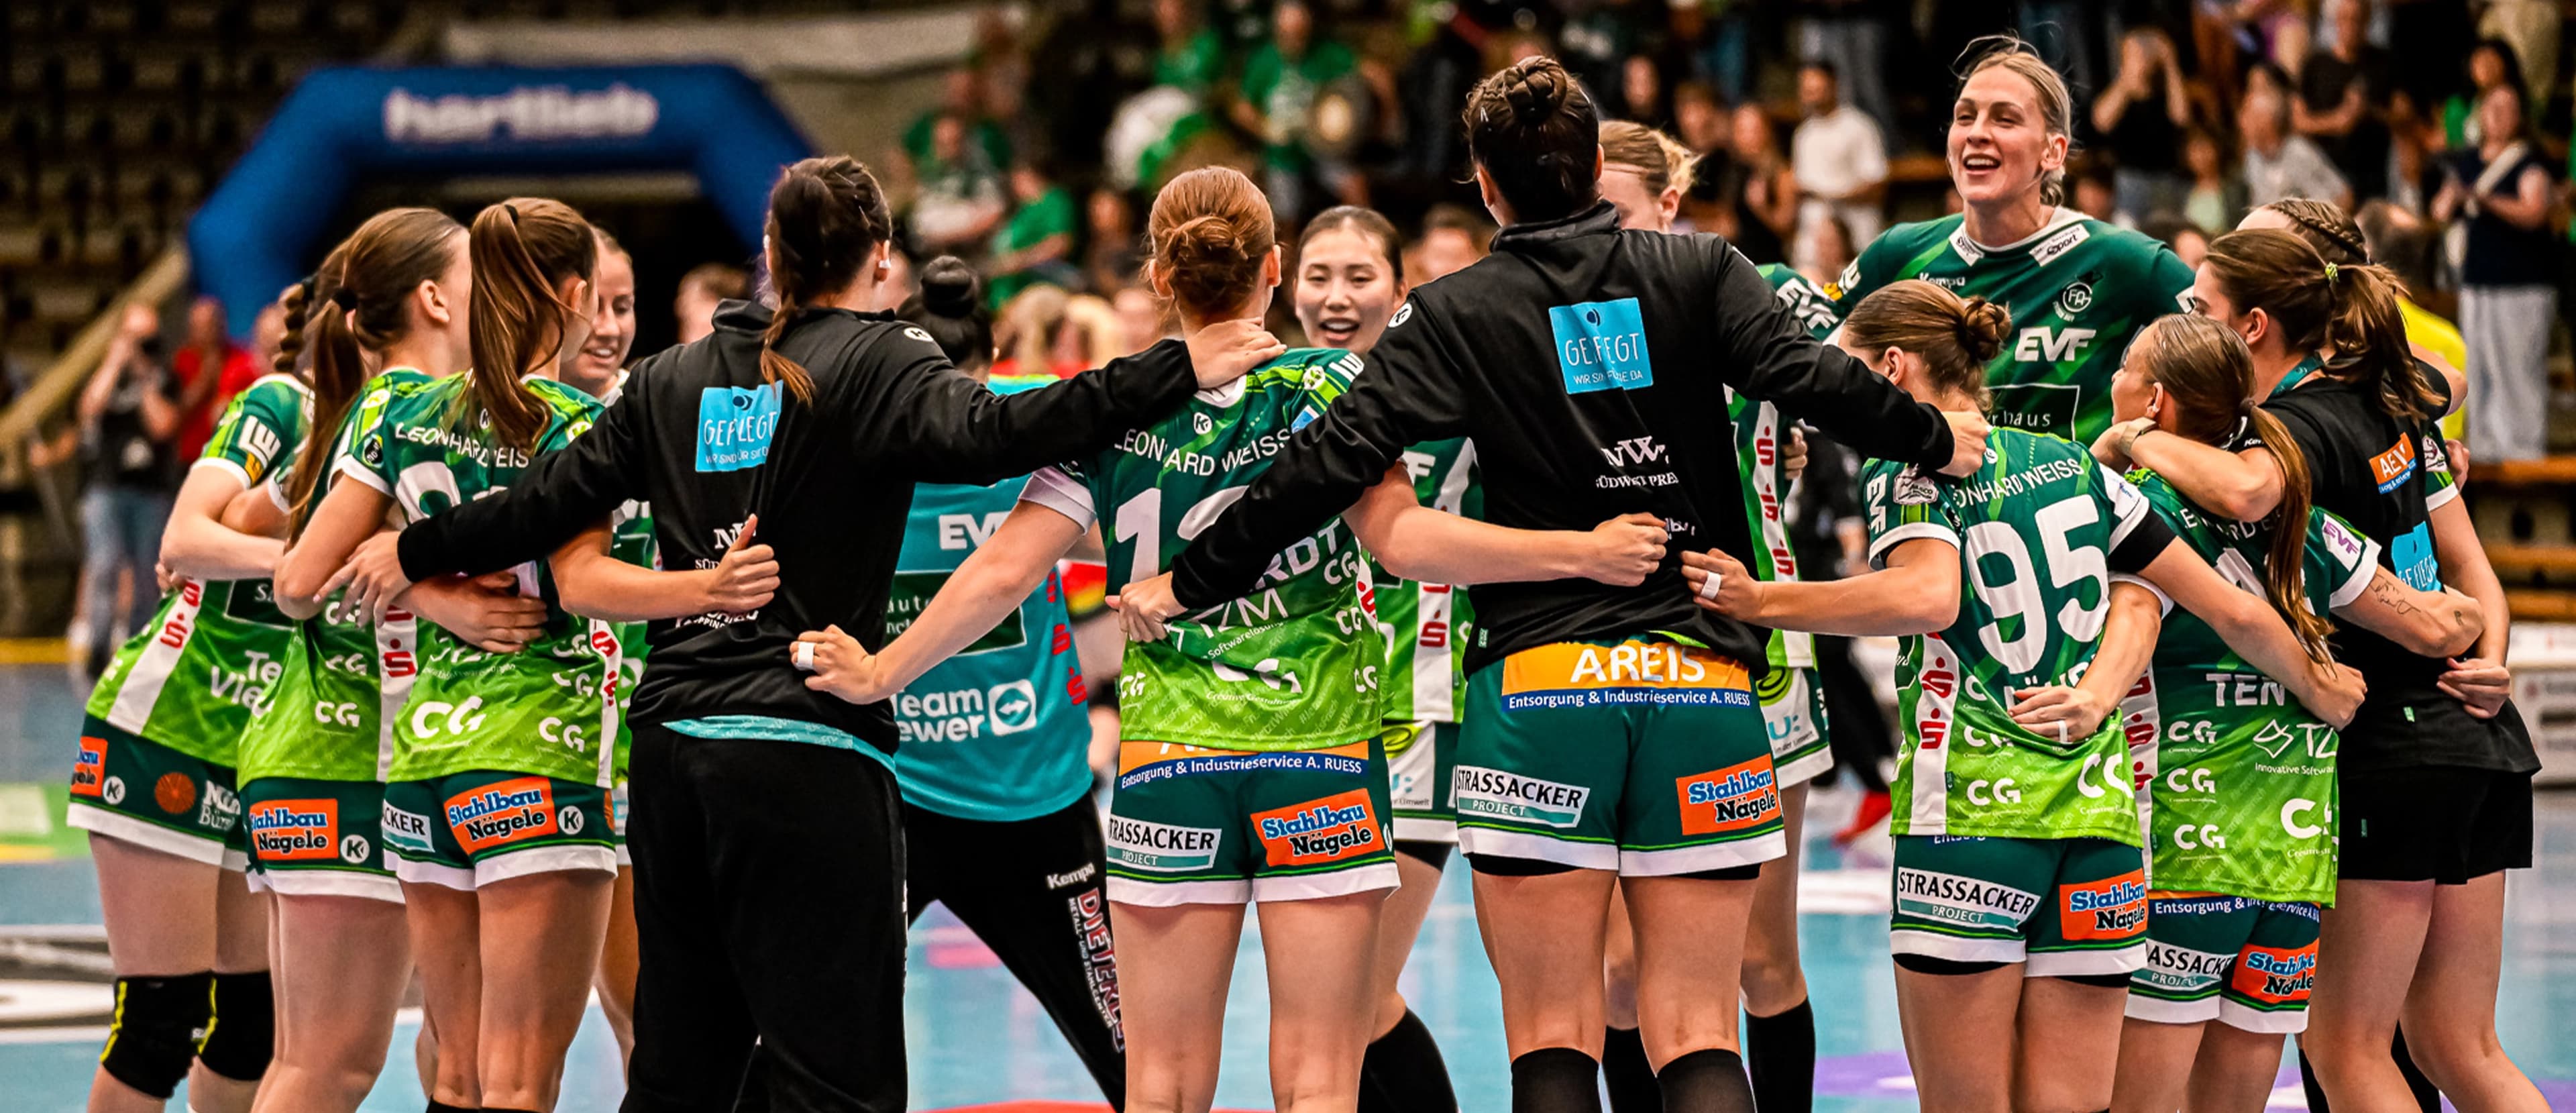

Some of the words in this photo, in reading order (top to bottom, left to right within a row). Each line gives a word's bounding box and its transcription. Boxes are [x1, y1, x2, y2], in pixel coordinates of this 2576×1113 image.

[2015, 327, 2096, 362] EVF
[2021, 458, 2085, 490] WEISS
[1965, 494, 2110, 675] 95
[1570, 644, 1705, 683] AREIS
[315, 700, 360, 727] CG
[1509, 691, 1585, 709] Entsorgung
[1589, 691, 1601, 704] &
[1604, 688, 1707, 704] Industrieservice
[1711, 690, 1722, 704] A.
[1724, 690, 1751, 707] RUESS
[411, 696, 487, 739] CG
[898, 714, 985, 742] ewer
[2168, 720, 2217, 744] CG
[539, 717, 585, 753] CG
[1121, 765, 1173, 790] Entsorgung
[1175, 761, 1188, 775] &
[1191, 756, 1301, 773] Industrieservice
[1305, 755, 1321, 769] A.
[1324, 758, 1362, 774] RUESS
[2166, 767, 2216, 794] CG
[2255, 762, 2300, 774] Innovative
[1457, 770, 1584, 809] STRASSACKER
[1688, 768, 1773, 805] Stahlbau
[1966, 778, 2022, 806] CG
[448, 788, 543, 827] Stahlbau
[1261, 803, 1368, 841] Stahlbau
[1472, 800, 1526, 817] PROJECT
[1715, 789, 1777, 824] Nägele
[466, 808, 546, 842] Nägele
[1289, 825, 1373, 857] Nägele
[2174, 824, 2226, 849] CG
[257, 830, 327, 854] Nägele
[1047, 862, 1095, 890] Kempa
[1898, 871, 2035, 916] STRASSACKER
[2155, 901, 2232, 915] Entsorgung
[2235, 897, 2245, 910] &
[1932, 905, 1984, 923] PROJECT
